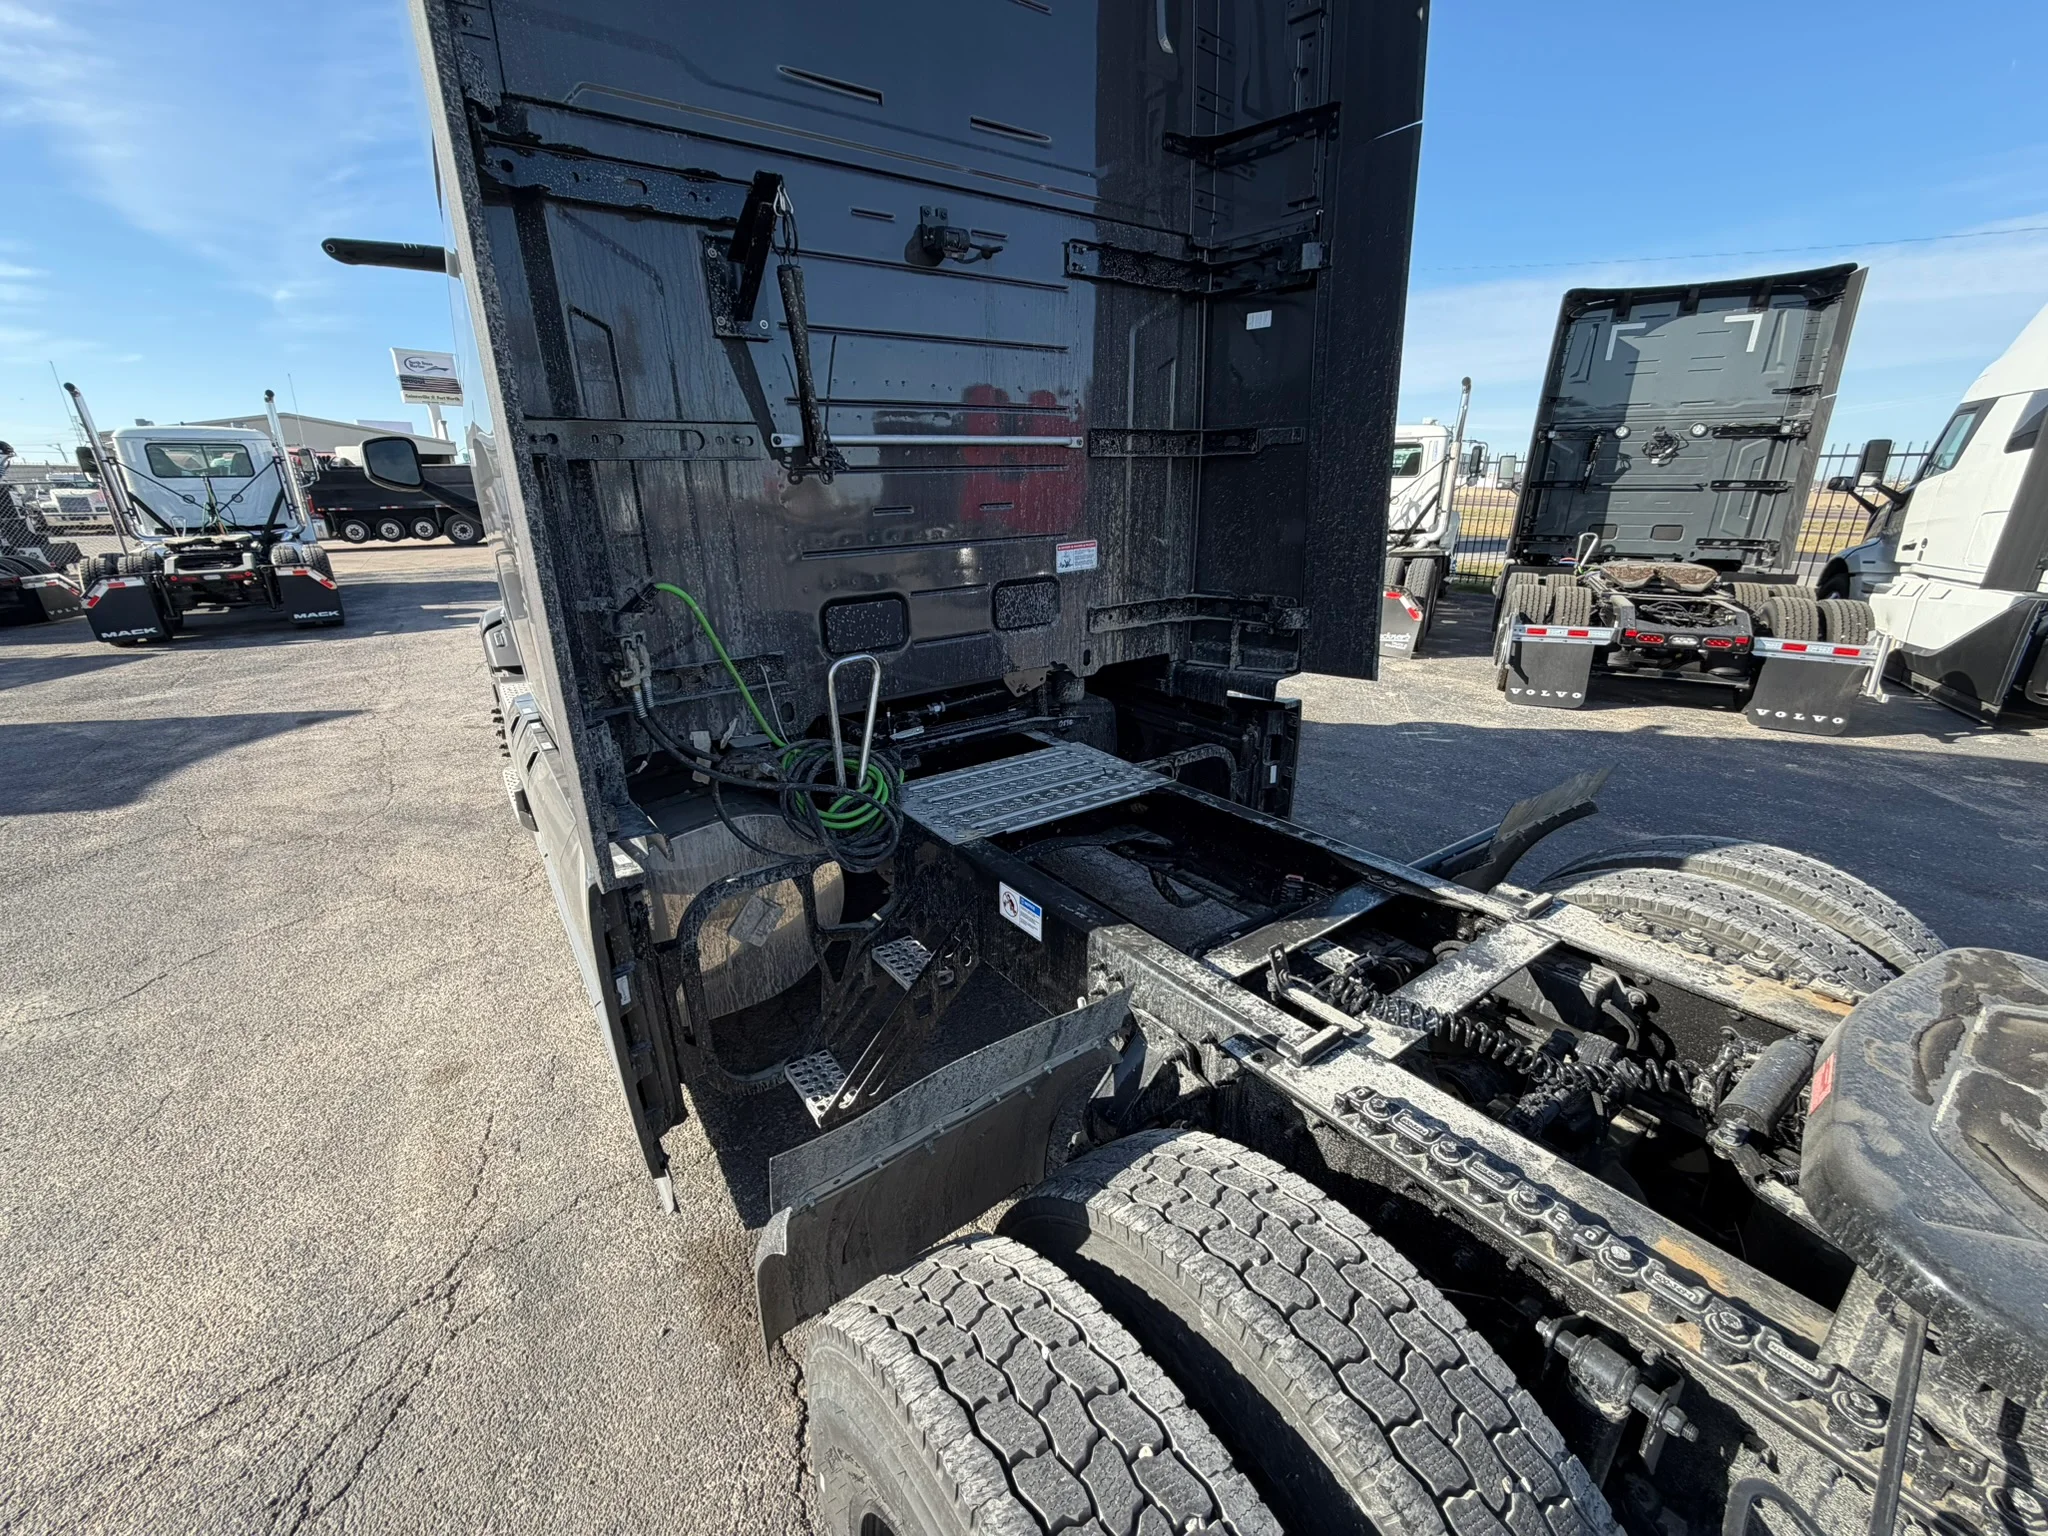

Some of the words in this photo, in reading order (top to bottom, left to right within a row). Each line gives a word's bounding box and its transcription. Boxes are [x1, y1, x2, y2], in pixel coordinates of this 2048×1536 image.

[293, 610, 340, 619] MACK
[101, 626, 158, 639] MACK
[1510, 687, 1582, 699] VOLVO
[1755, 708, 1844, 724] VOLVO
